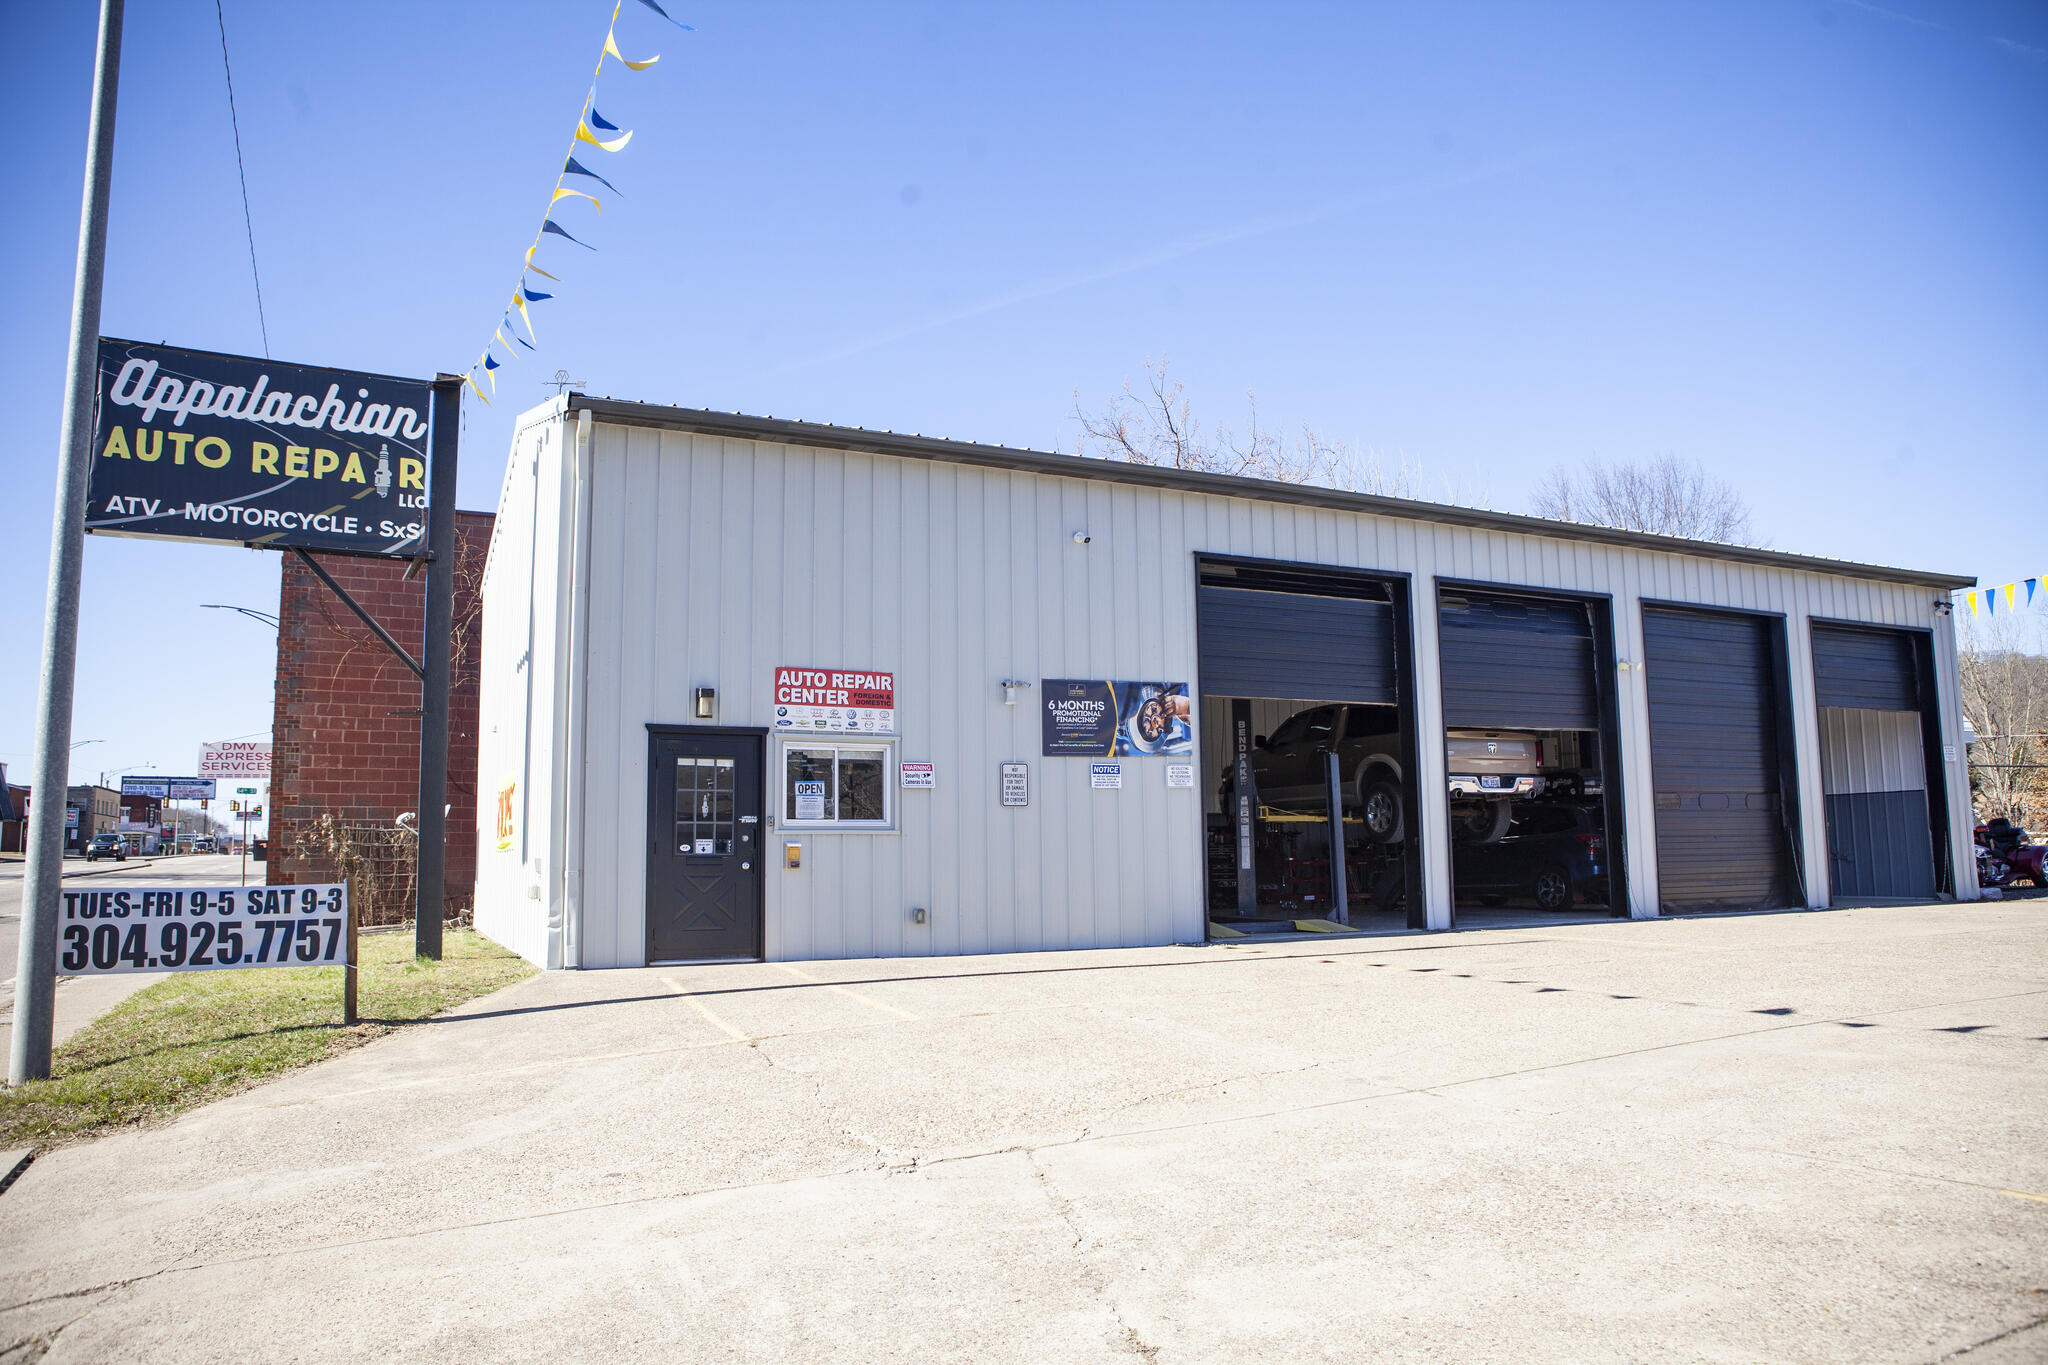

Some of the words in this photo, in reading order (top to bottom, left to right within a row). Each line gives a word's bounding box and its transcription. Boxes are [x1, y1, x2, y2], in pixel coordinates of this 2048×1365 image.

[102, 425, 232, 468] AUTO
[104, 495, 161, 517] ATV
[184, 502, 358, 535] MOTORCYCLE
[379, 520, 421, 540] SxS
[778, 671, 827, 687] AUTO
[832, 673, 893, 691] REPAIR
[778, 687, 849, 705] CENTER
[856, 699, 891, 707] DOMESTIC
[1048, 700, 1055, 710] 6
[1058, 700, 1105, 711] MONTHS
[206, 752, 272, 760] EXPRESS
[1238, 721, 1247, 775] BENDPAK
[202, 762, 272, 770] SERVICES
[797, 784, 823, 794] OPEN
[63, 892, 182, 919] TUES-FRI
[190, 890, 235, 916] 9-5
[247, 889, 295, 915] SAT
[301, 888, 343, 913] 9-3
[62, 918, 342, 970] 304.925.7757
